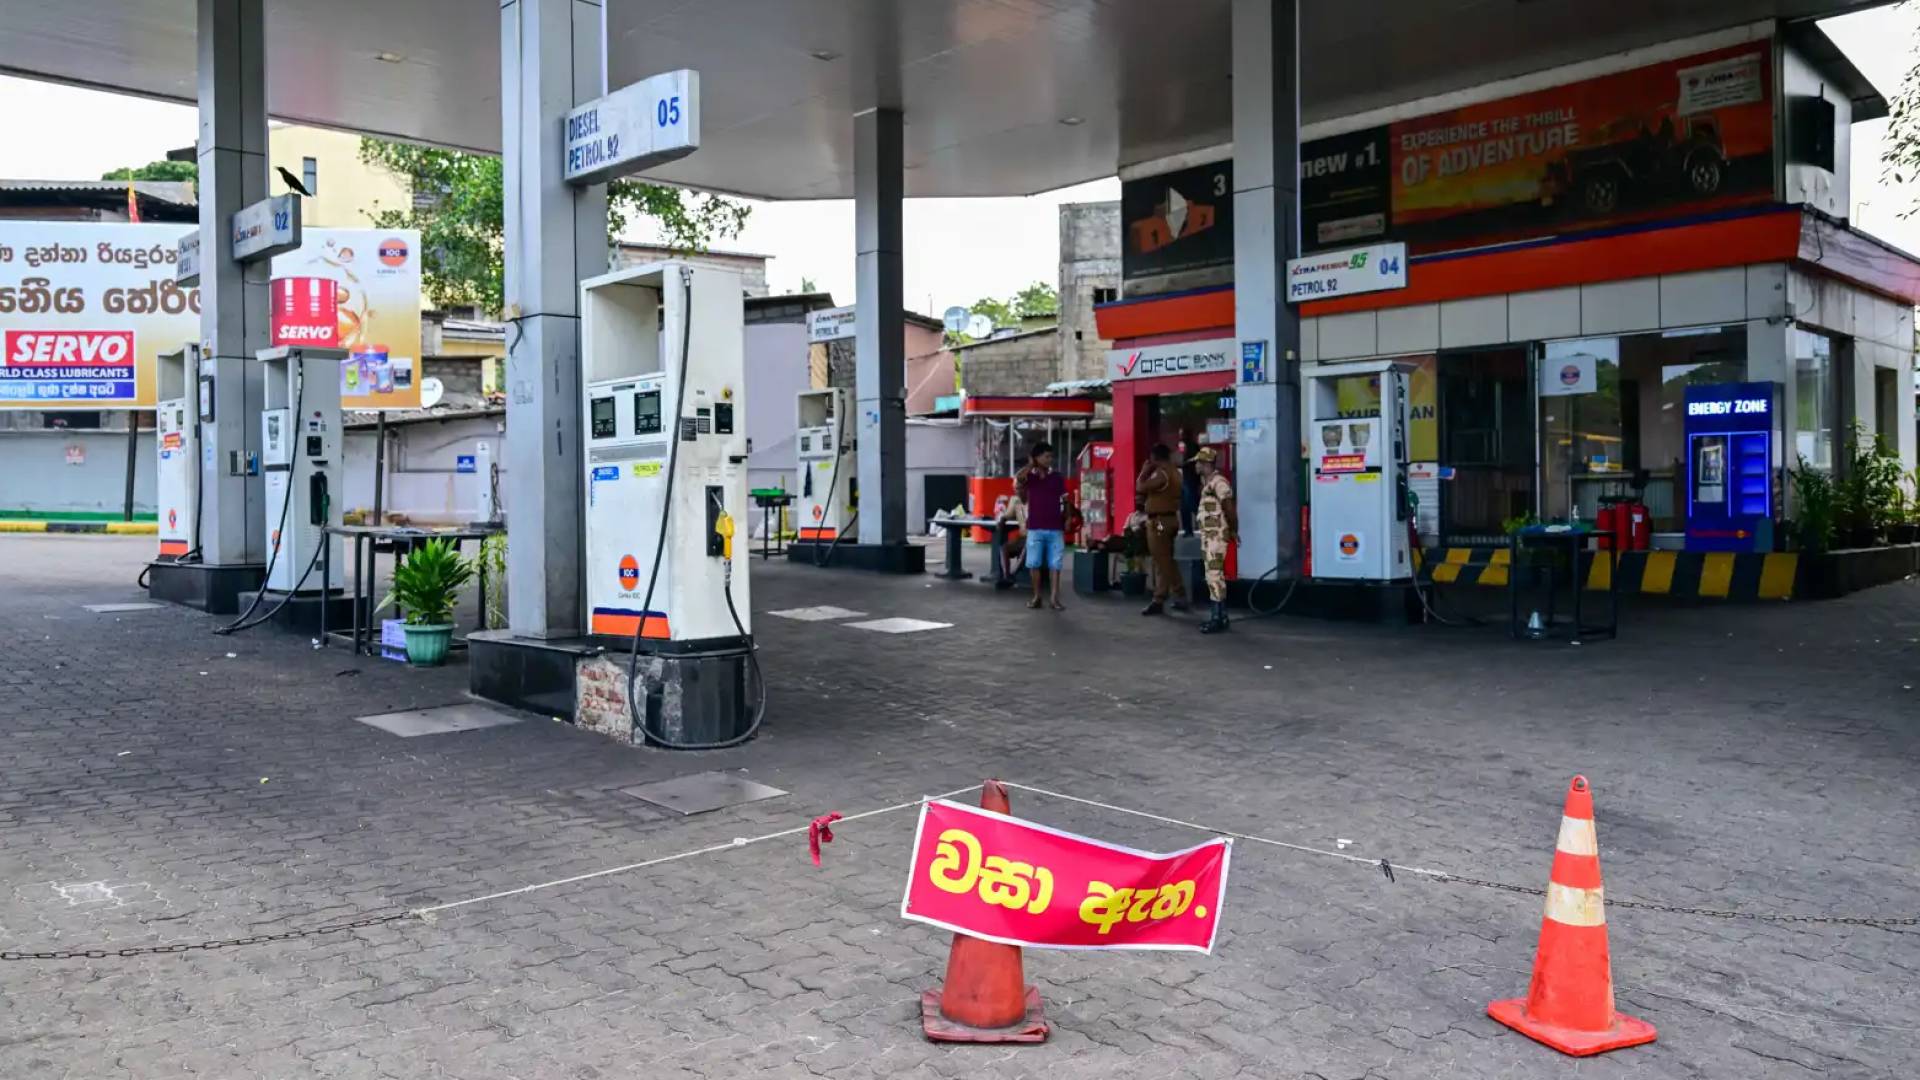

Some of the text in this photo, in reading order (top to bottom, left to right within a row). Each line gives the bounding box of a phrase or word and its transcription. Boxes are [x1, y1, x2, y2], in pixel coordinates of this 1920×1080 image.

[658, 96, 680, 127] 05
[569, 108, 600, 142] DIESEL
[1402, 107, 1576, 150] EXPERIENCE THE THRILL
[569, 134, 619, 172] PETROL 92
[1402, 123, 1580, 186] OF ADVENTURE
[1213, 173, 1226, 197] 3
[1301, 151, 1347, 179] new
[275, 211, 289, 230] 02
[1379, 257, 1399, 275] 04
[1291, 278, 1338, 296] PETROL 92
[280, 325, 332, 339] SERVO
[12, 334, 128, 363] SERVO
[1193, 352, 1225, 364] BANK
[22, 368, 58, 378] CLASS
[60, 368, 129, 378] LUBRICANTS
[1688, 399, 1767, 416] ENERGY ZONE
[623, 568, 635, 578] IOC
[929, 829, 1054, 915] වසා
